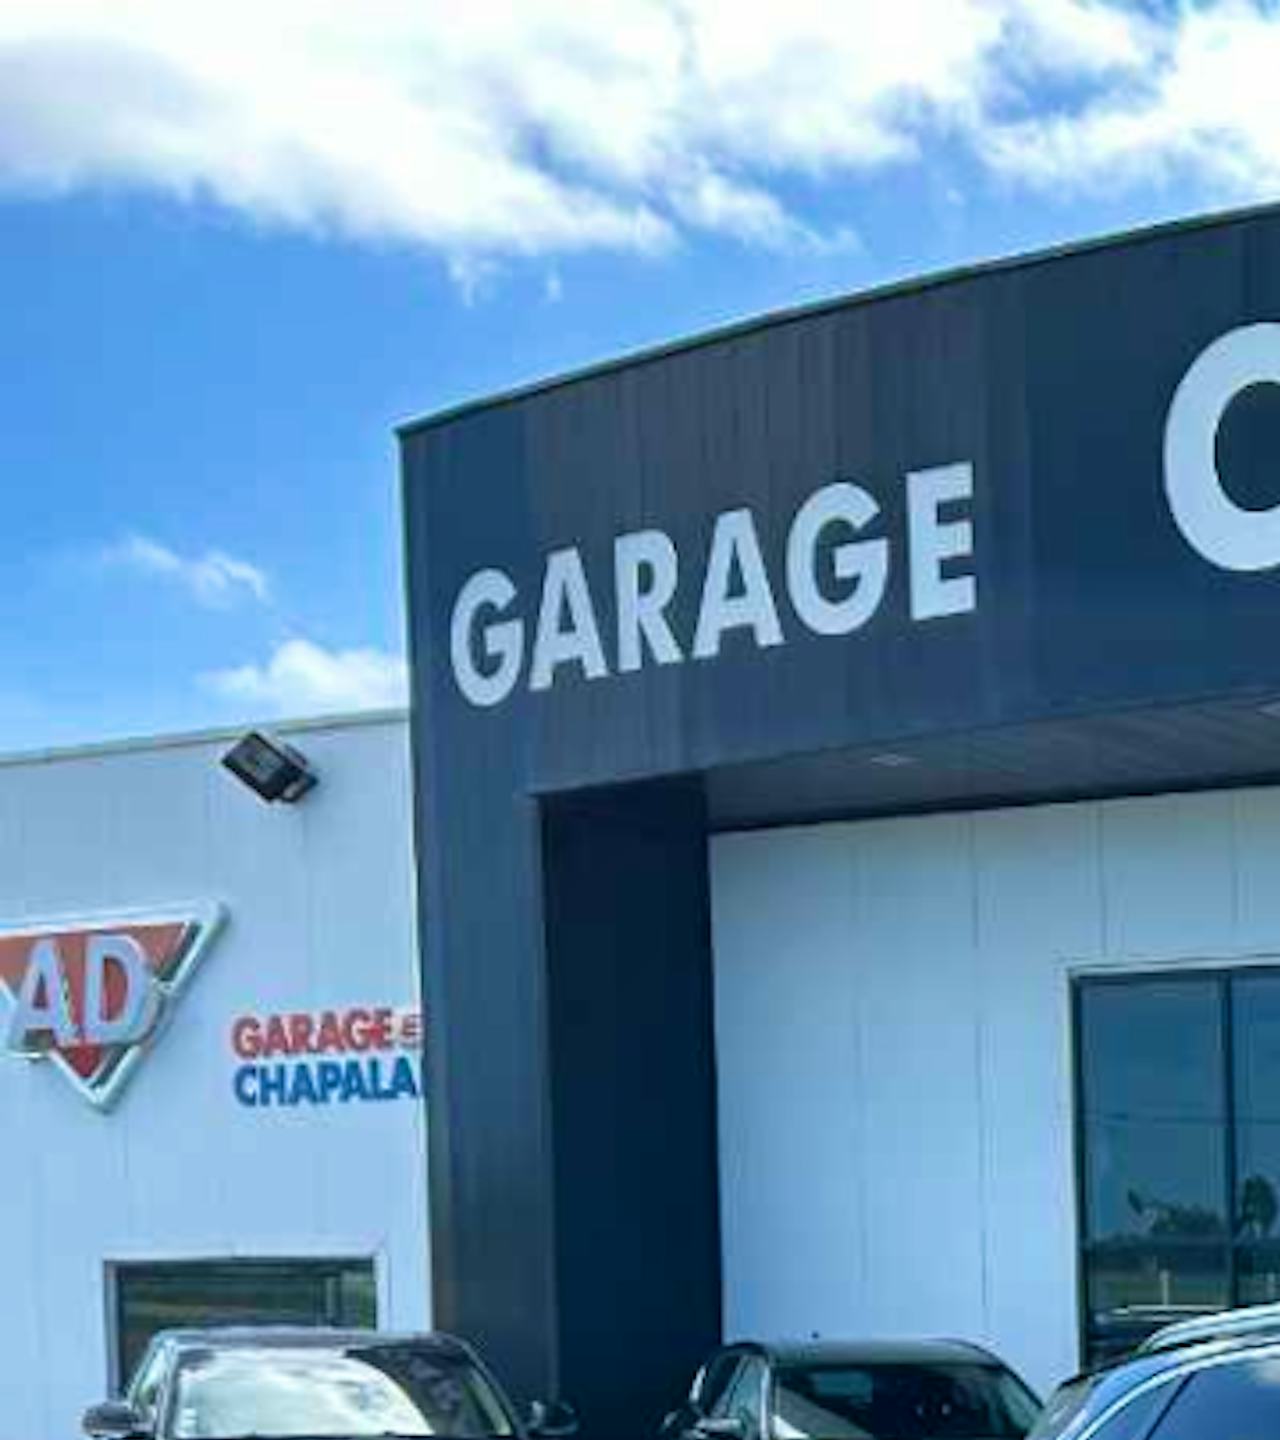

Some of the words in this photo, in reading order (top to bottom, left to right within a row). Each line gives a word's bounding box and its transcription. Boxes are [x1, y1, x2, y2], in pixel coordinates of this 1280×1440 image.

[450, 460, 976, 707] GARAGE
[5, 935, 154, 1050] AD
[233, 1008, 393, 1058] GARAGE
